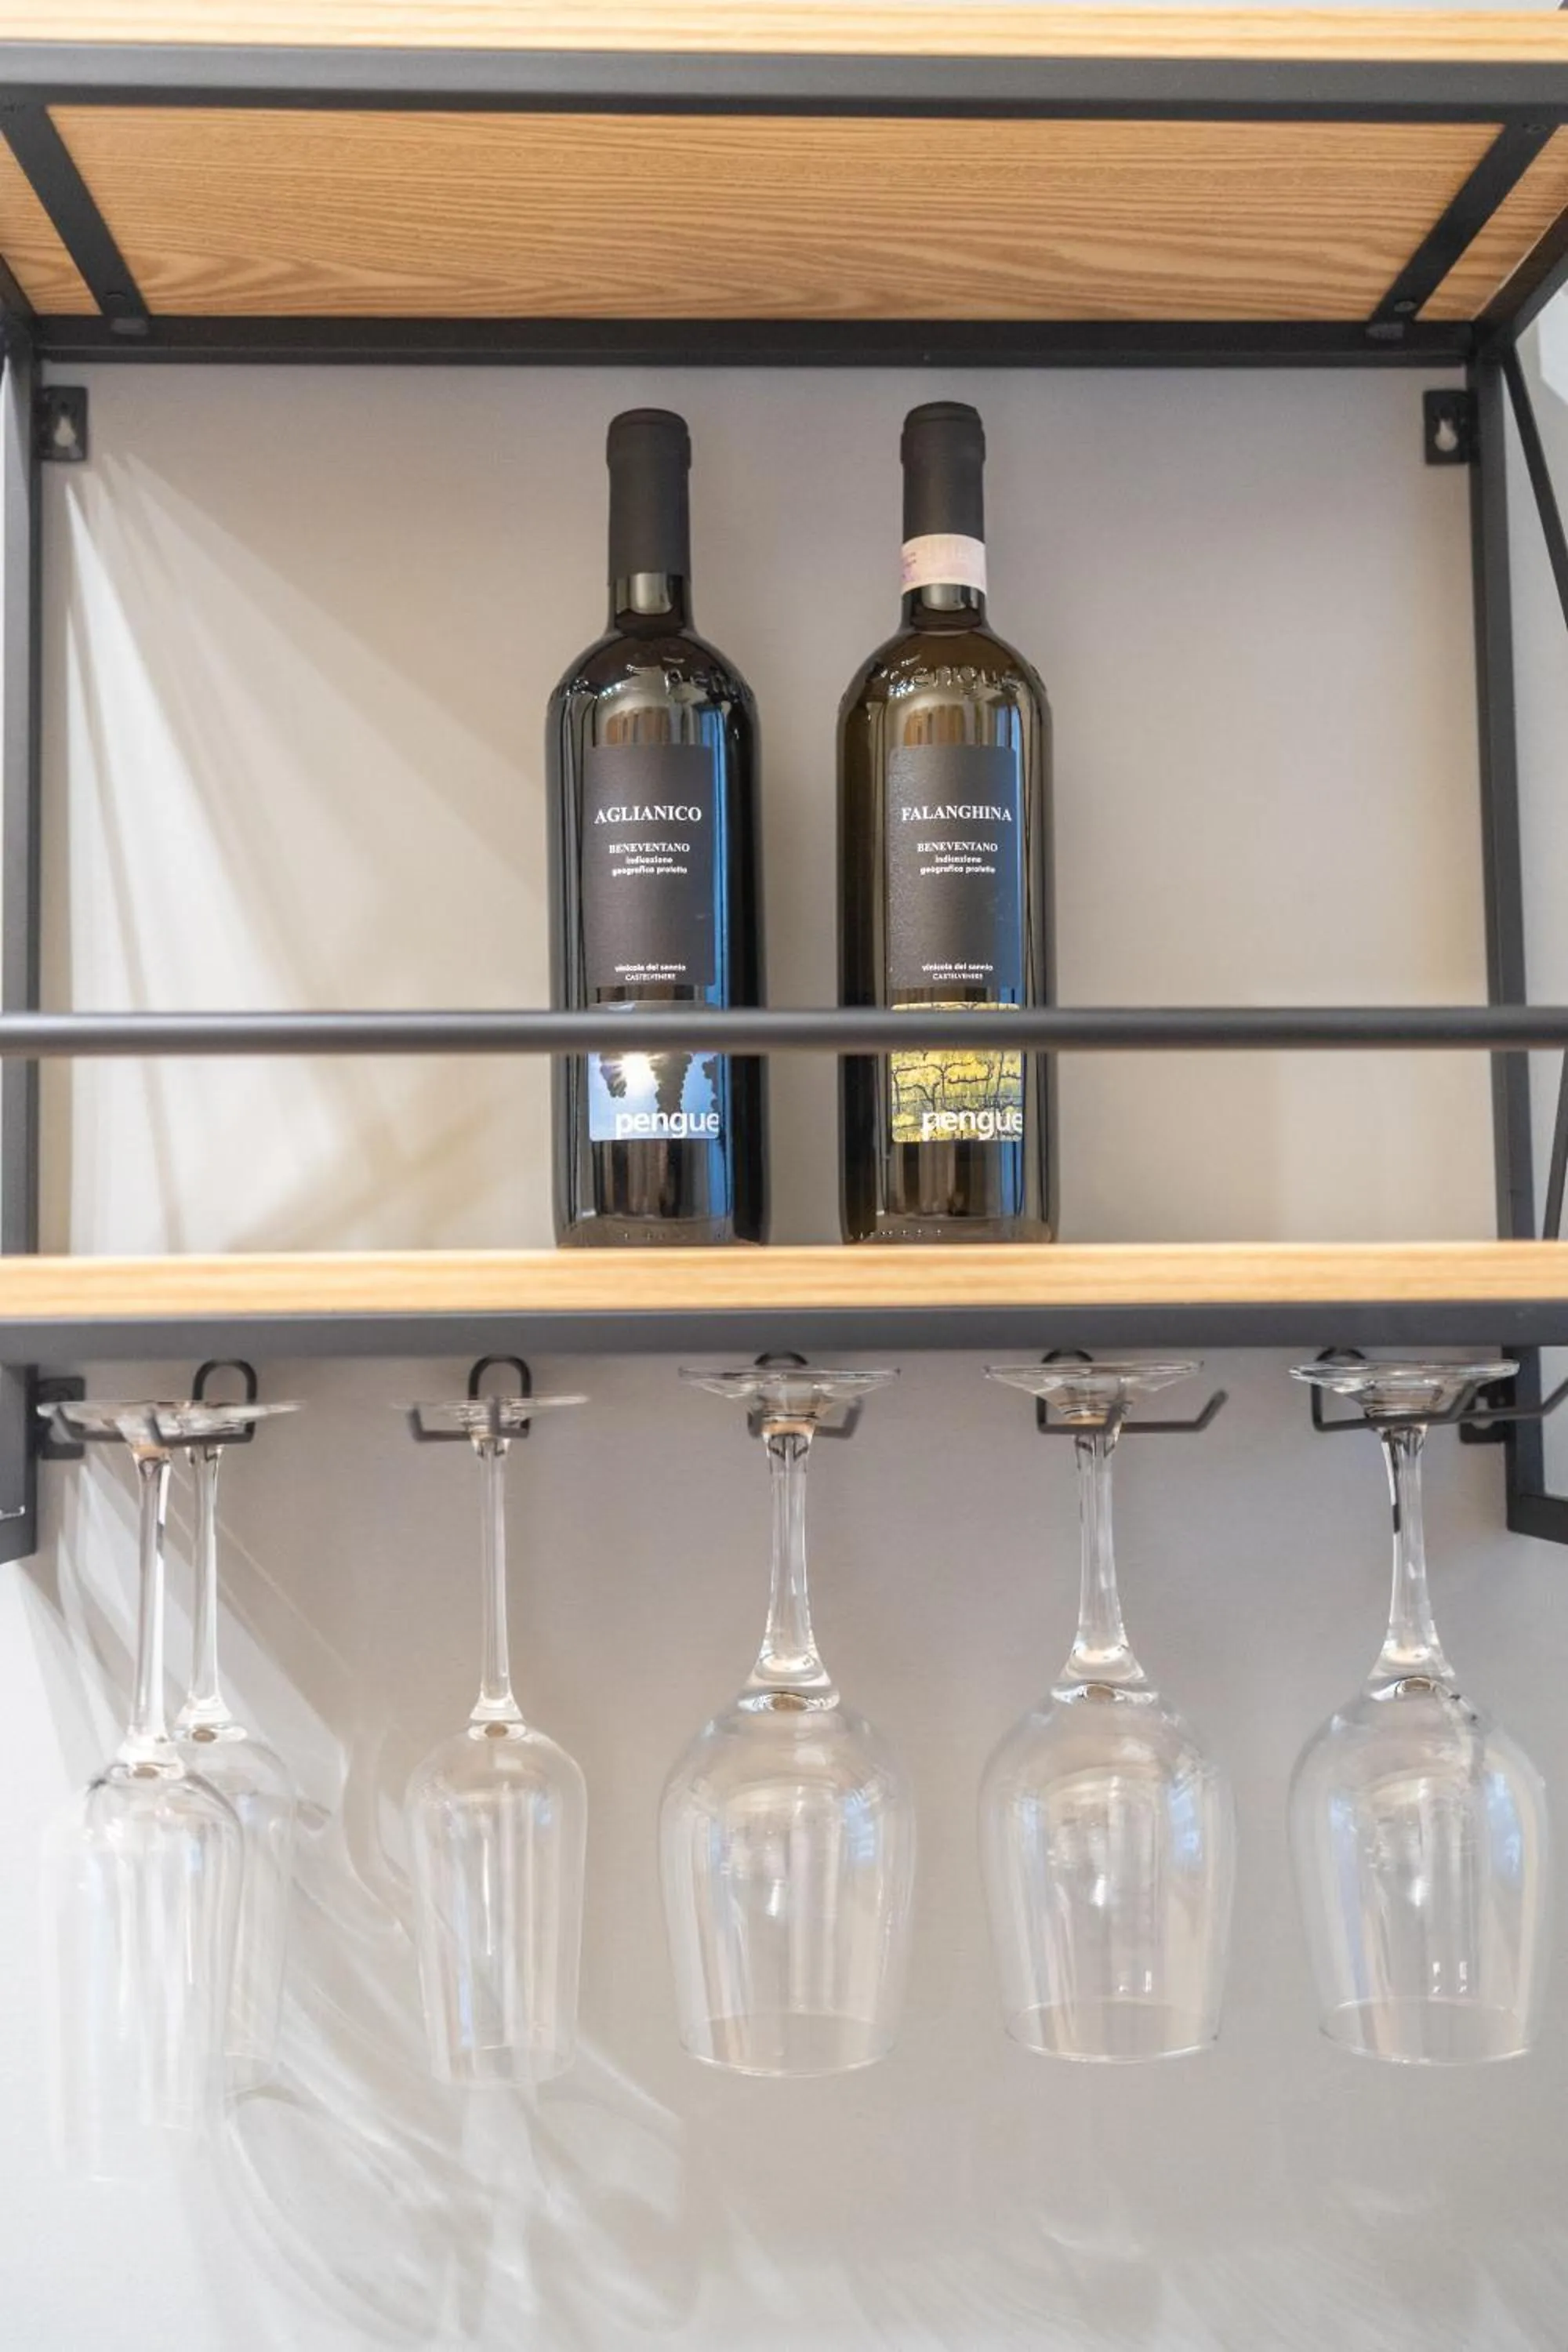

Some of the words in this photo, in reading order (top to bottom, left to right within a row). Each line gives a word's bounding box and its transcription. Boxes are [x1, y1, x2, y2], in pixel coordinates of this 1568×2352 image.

[593, 805, 702, 824] AGLIANICO
[902, 805, 1012, 822] FALANGHINA
[608, 842, 691, 854] BENEVENTANO
[916, 841, 998, 852] BENEVENTANO
[626, 855, 673, 864] indicazione
[935, 855, 982, 863] indicazione
[954, 962, 967, 971] del
[615, 1112, 720, 1139] pengue
[920, 1111, 1022, 1142] pengue
